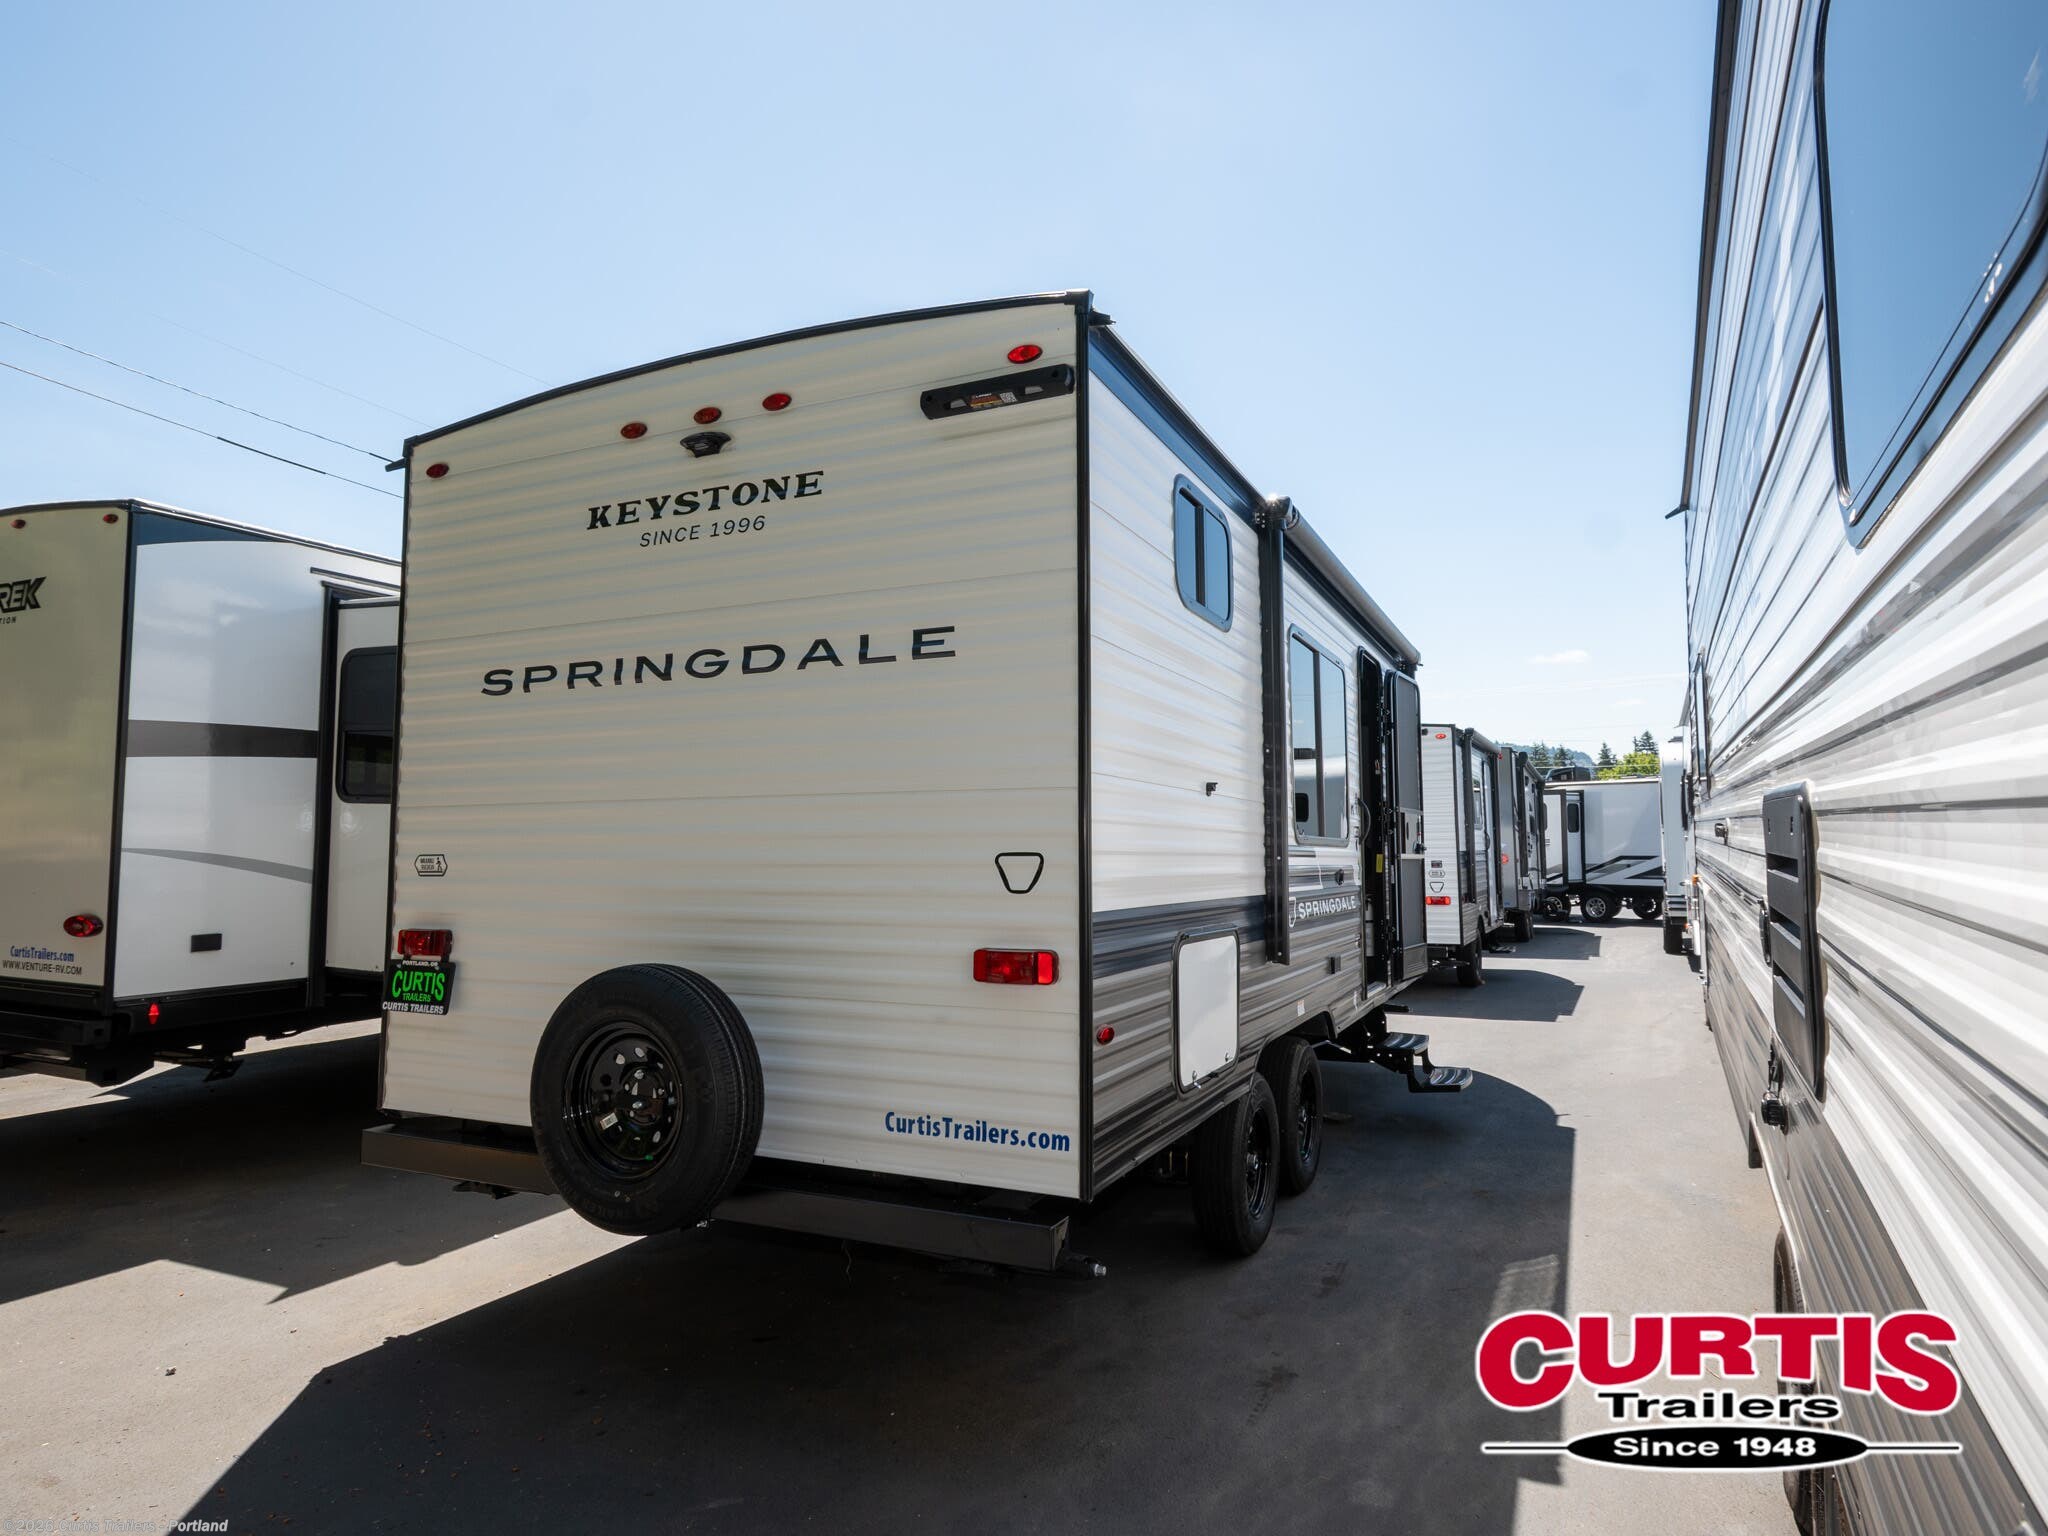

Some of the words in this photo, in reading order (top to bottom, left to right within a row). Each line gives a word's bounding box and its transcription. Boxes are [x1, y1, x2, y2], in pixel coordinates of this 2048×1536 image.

[587, 470, 825, 530] KEYSTONE
[639, 524, 701, 548] SINCE
[709, 515, 766, 538] 1996
[481, 625, 956, 696] SPRINGDALE
[1298, 895, 1357, 919] SPRINGDALE
[10, 945, 75, 962] CurtisTrailers.com
[2, 960, 82, 975] WWW.VENTURE-RV.COM
[392, 970, 446, 1001] CURTIS
[402, 993, 432, 1003] TRAILERS
[382, 1001, 409, 1011] CURTIS
[410, 1003, 445, 1015] TRAILERS
[884, 1111, 1070, 1152] CurtisTrailers.com
